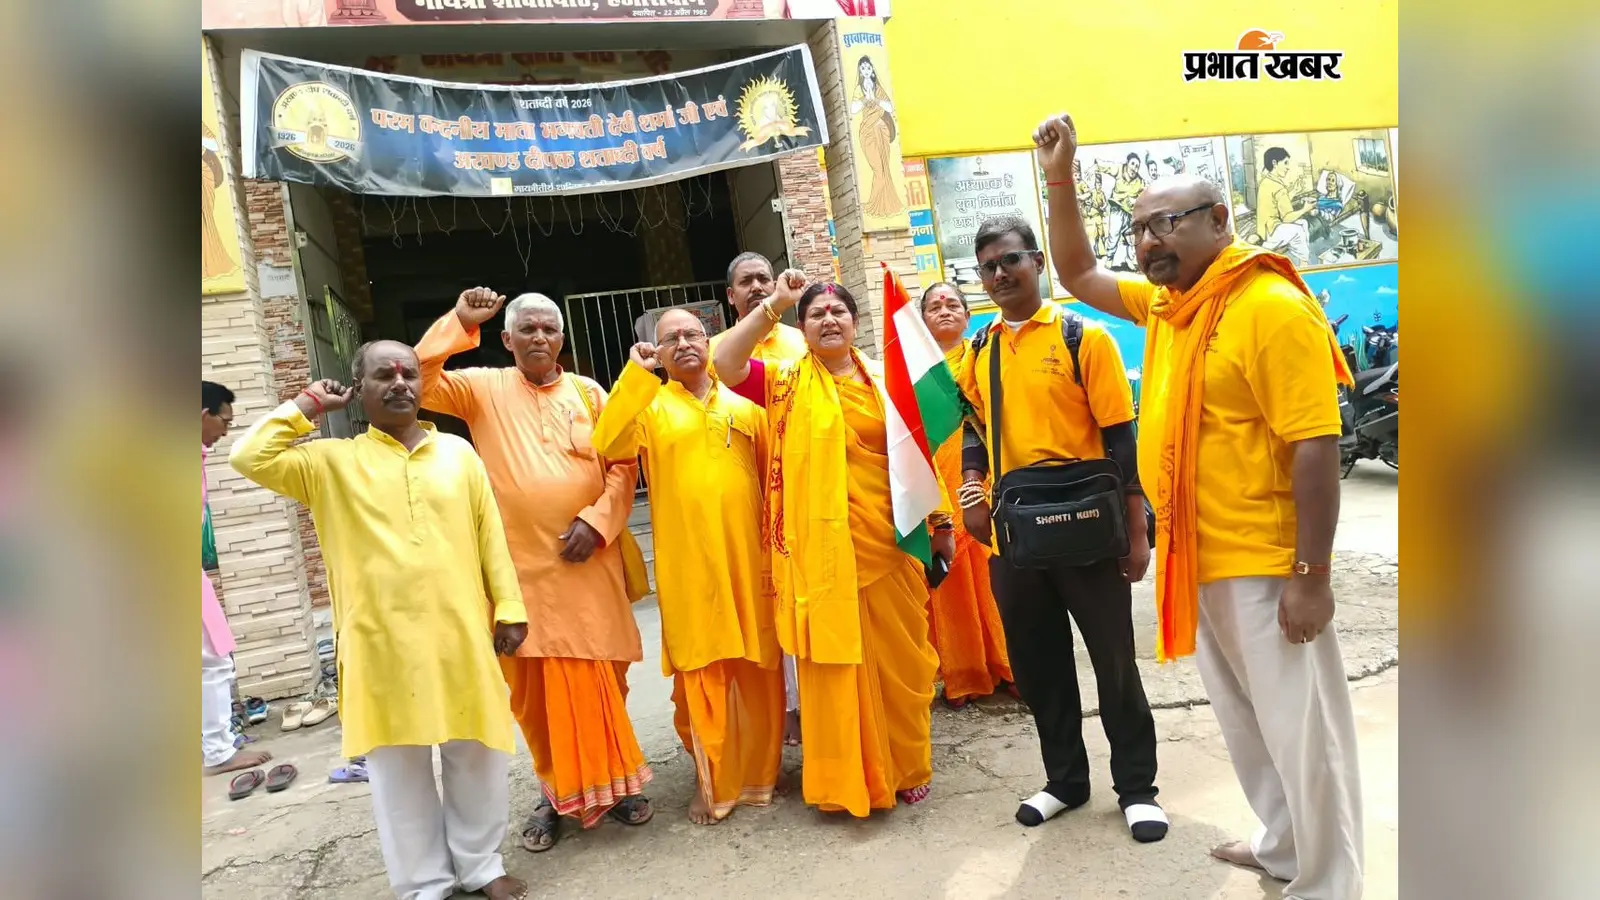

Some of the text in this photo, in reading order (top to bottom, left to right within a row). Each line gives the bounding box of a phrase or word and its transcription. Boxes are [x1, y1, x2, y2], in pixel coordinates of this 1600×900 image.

[843, 32, 883, 48] सुस्वागतम्
[519, 96, 593, 110] शताब्दी वर्ष 2026
[370, 94, 728, 141] परम वन्दनीय माता भगवती देवी शर्मा जी एवं
[277, 132, 297, 141] 1926
[334, 140, 356, 151] 2026
[454, 135, 667, 171] अखण्ड दीपक शताब्दी वर्ष
[955, 178, 1002, 193] अध्यापक
[955, 199, 976, 213] युग
[1035, 513, 1072, 525] SHANTI
